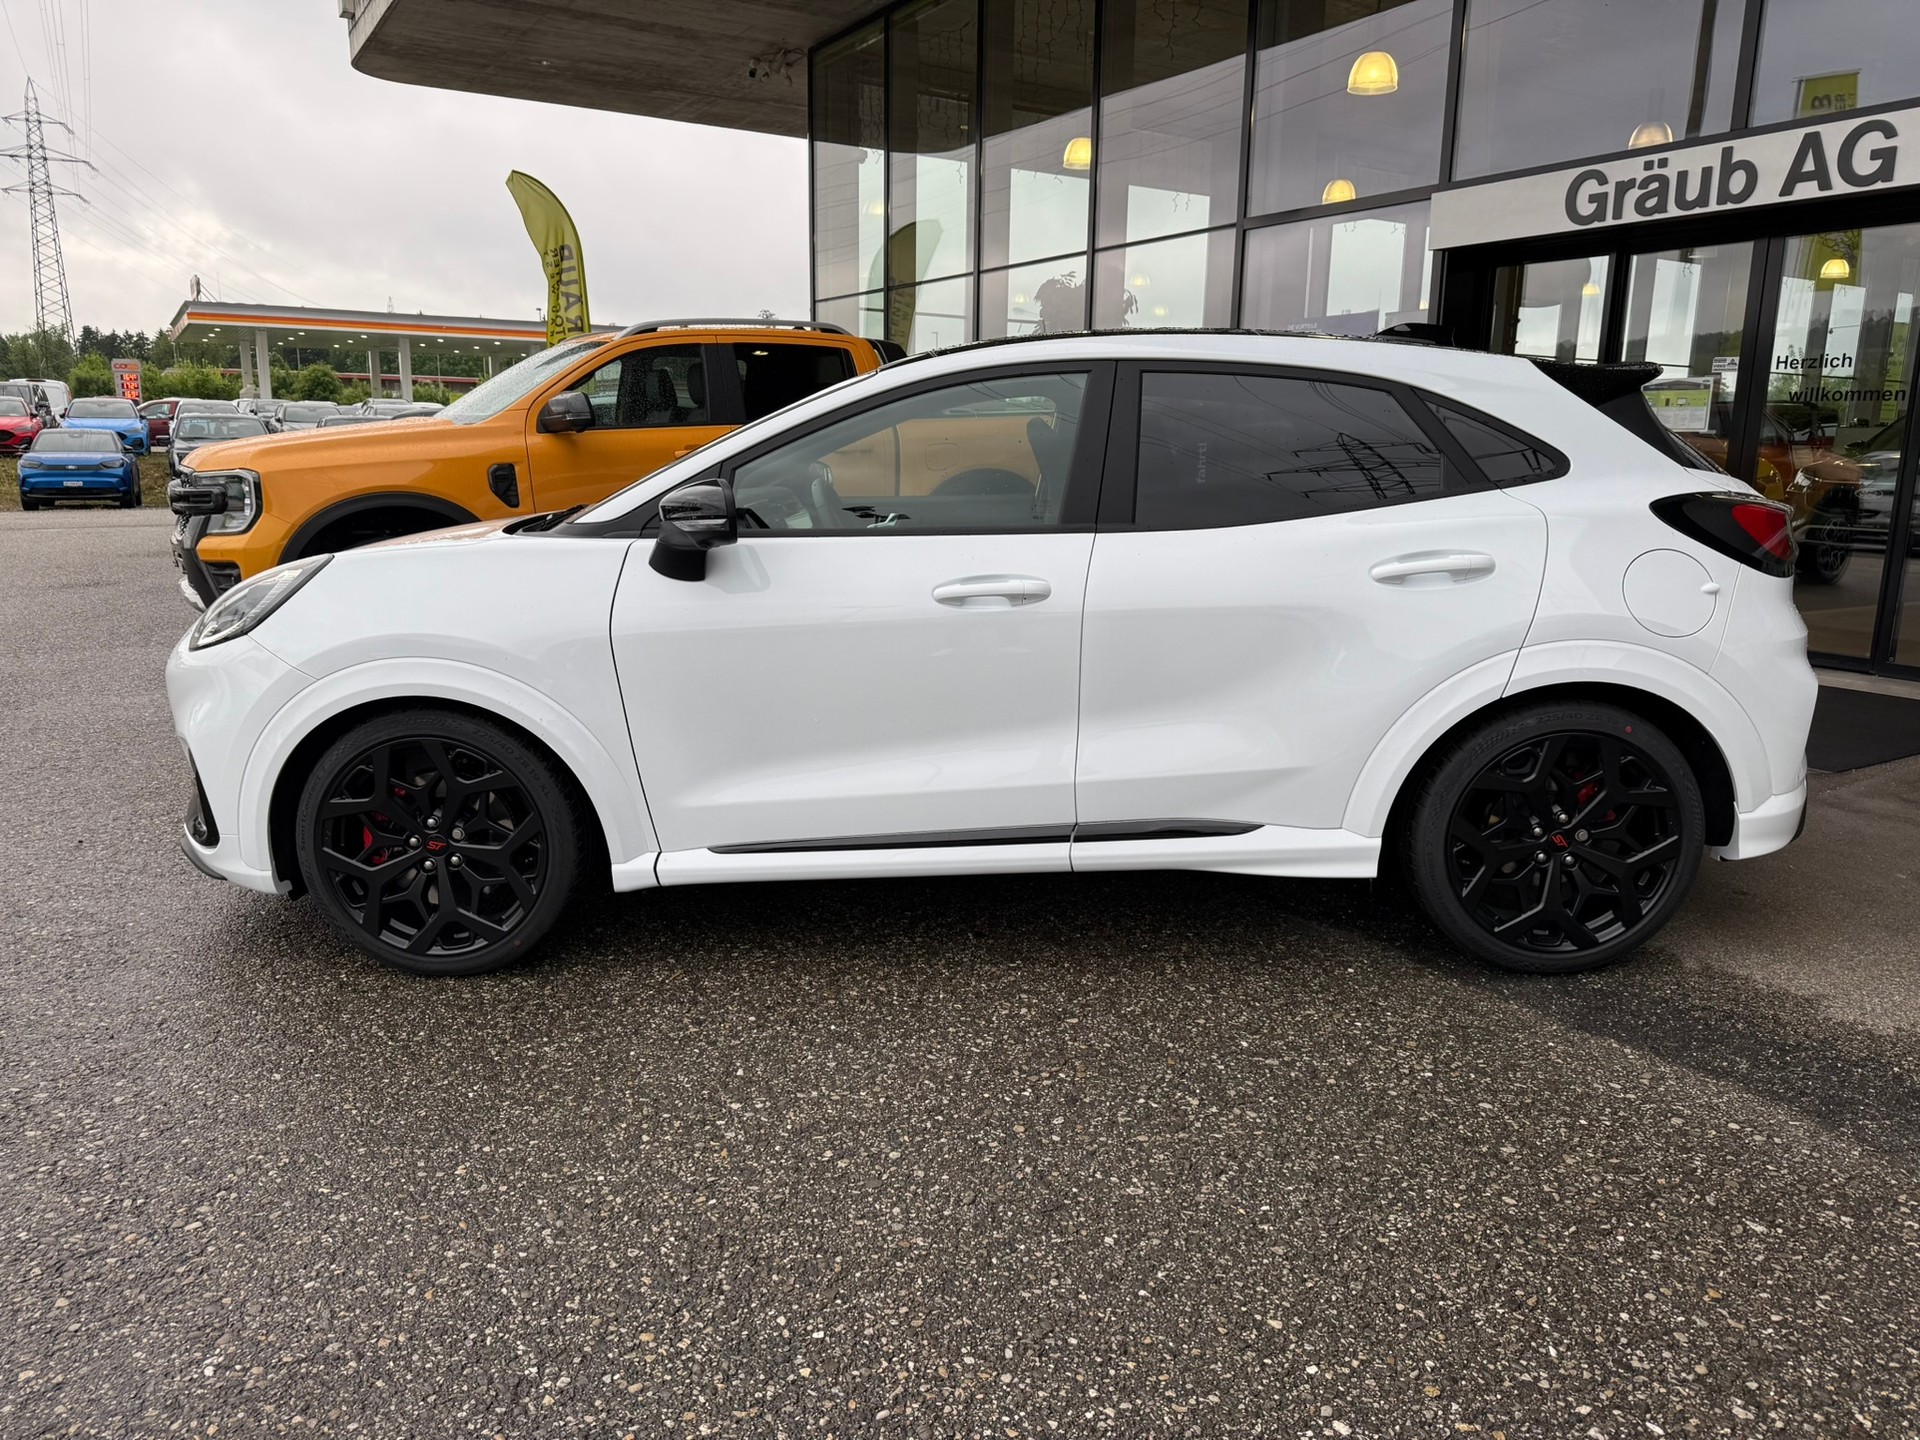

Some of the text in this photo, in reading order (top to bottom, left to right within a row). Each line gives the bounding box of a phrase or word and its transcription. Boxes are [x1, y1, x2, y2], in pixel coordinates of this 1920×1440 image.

[1565, 119, 1898, 225] Gräub AG
[1775, 353, 1853, 370] Herzlich
[1788, 387, 1906, 402] willkommen
[426, 840, 447, 851] ST
[1551, 834, 1569, 848] ST
